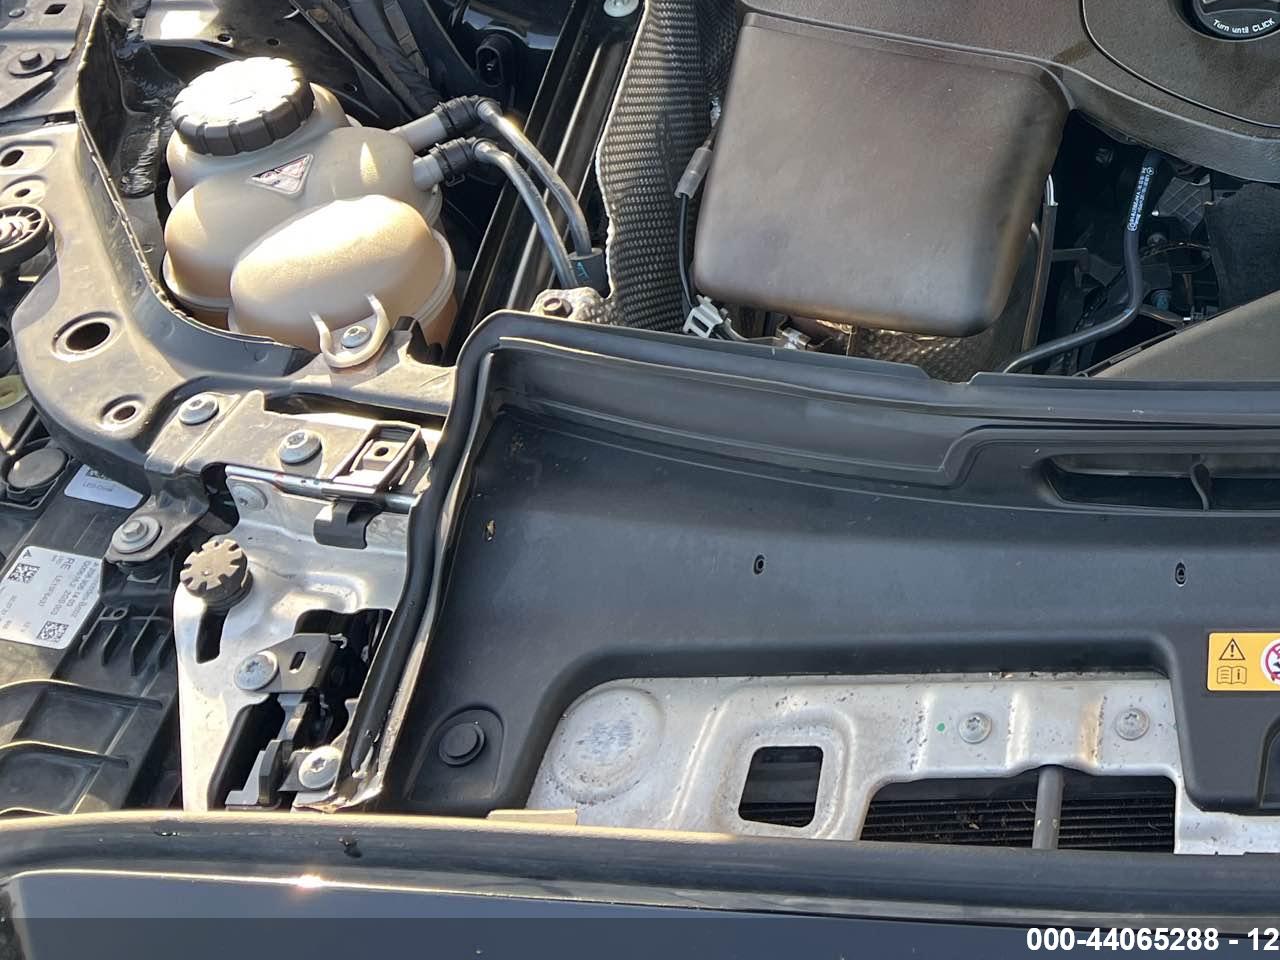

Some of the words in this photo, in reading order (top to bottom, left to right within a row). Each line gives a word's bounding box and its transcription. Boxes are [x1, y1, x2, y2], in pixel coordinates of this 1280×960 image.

[1213, 19, 1230, 32] Turn
[1231, 26, 1249, 34] until
[1252, 17, 1276, 32] CLICK
